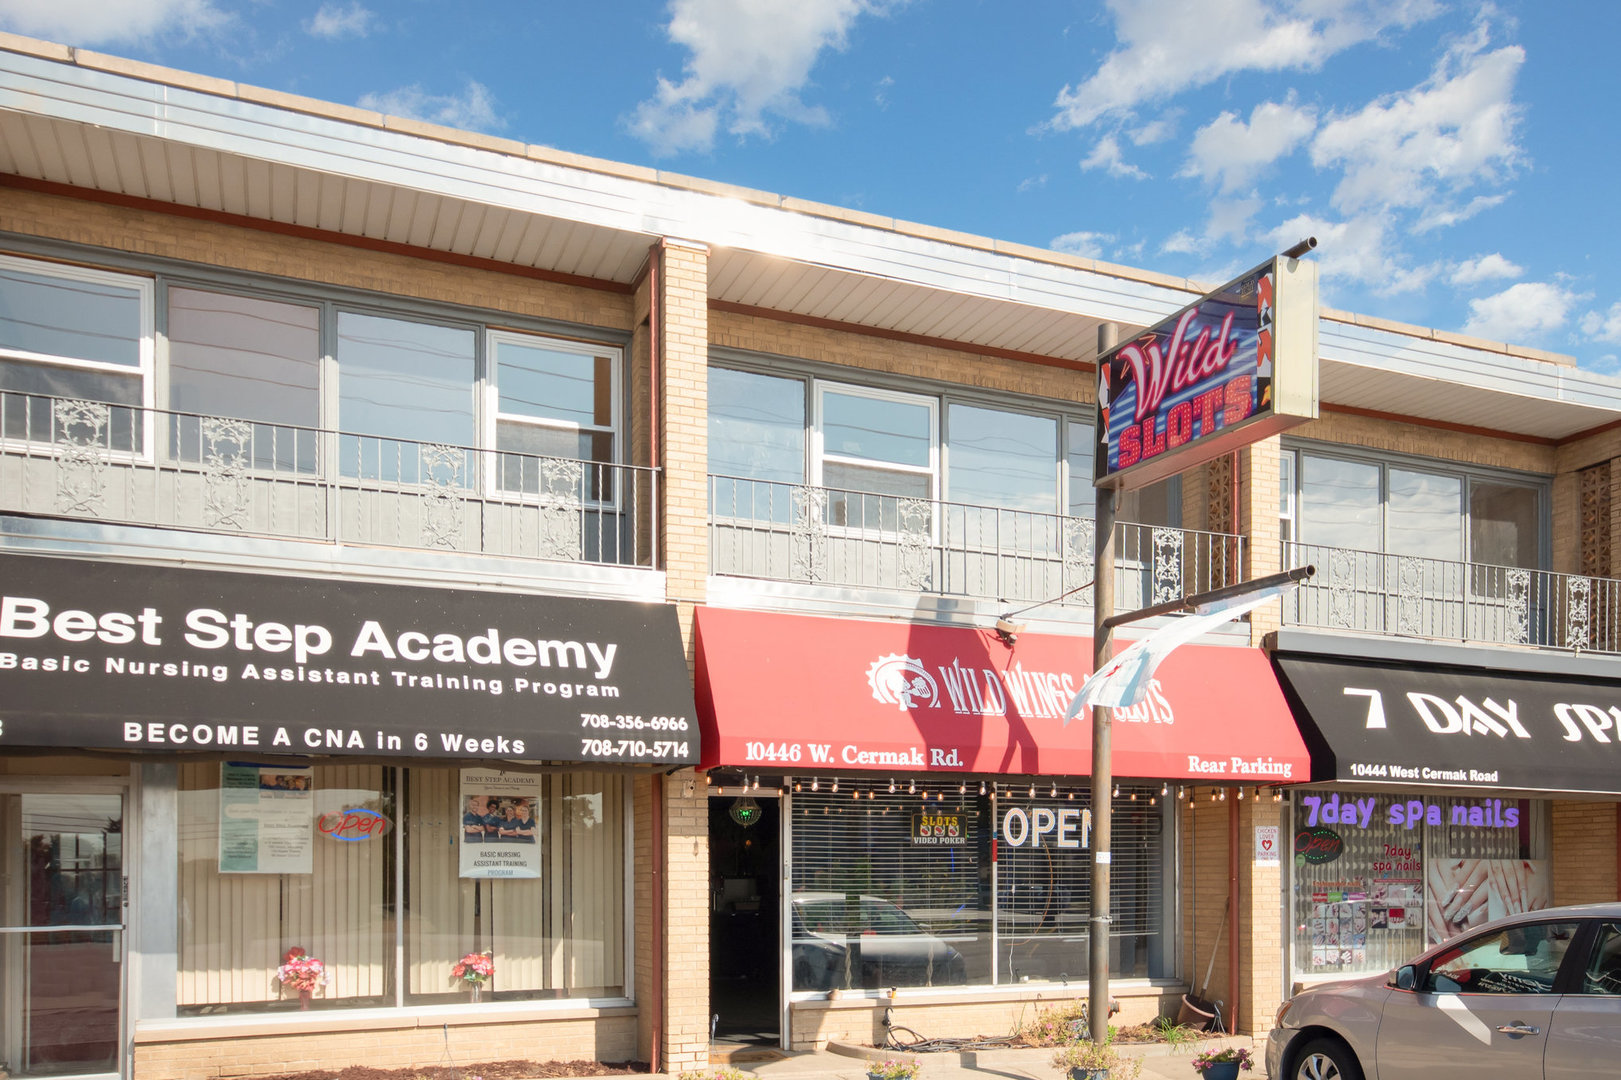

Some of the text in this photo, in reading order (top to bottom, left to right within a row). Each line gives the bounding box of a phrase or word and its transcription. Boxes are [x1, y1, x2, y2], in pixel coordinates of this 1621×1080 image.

[1118, 307, 1237, 423] Wild
[1118, 375, 1253, 468] SLOTS
[0, 595, 618, 680] Best Step Academy
[0, 652, 620, 699] Basic Nursing Assistant Training Program
[938, 656, 1007, 717] WILD
[1001, 660, 1084, 720] WINGS
[581, 713, 689, 731] 708-356-6966
[1343, 687, 1387, 728] 7
[1406, 691, 1532, 738] DAY
[123, 721, 526, 755] BECOME A CNA in 6 Weeks
[581, 738, 689, 758] 708-710-5714
[745, 741, 964, 767] 10446 W. Cermak Rd.
[1187, 755, 1293, 778] Rear Parking
[1350, 763, 1499, 783] 10444 West Cermak Road
[318, 810, 387, 836] Open
[921, 816, 958, 826] SLOTS
[1304, 793, 1520, 830] 7day spa nails
[913, 836, 966, 845] VIDEO POKER
[1295, 831, 1340, 854] Open
[1383, 843, 1412, 860] 7day
[1373, 858, 1422, 874] spa nails
